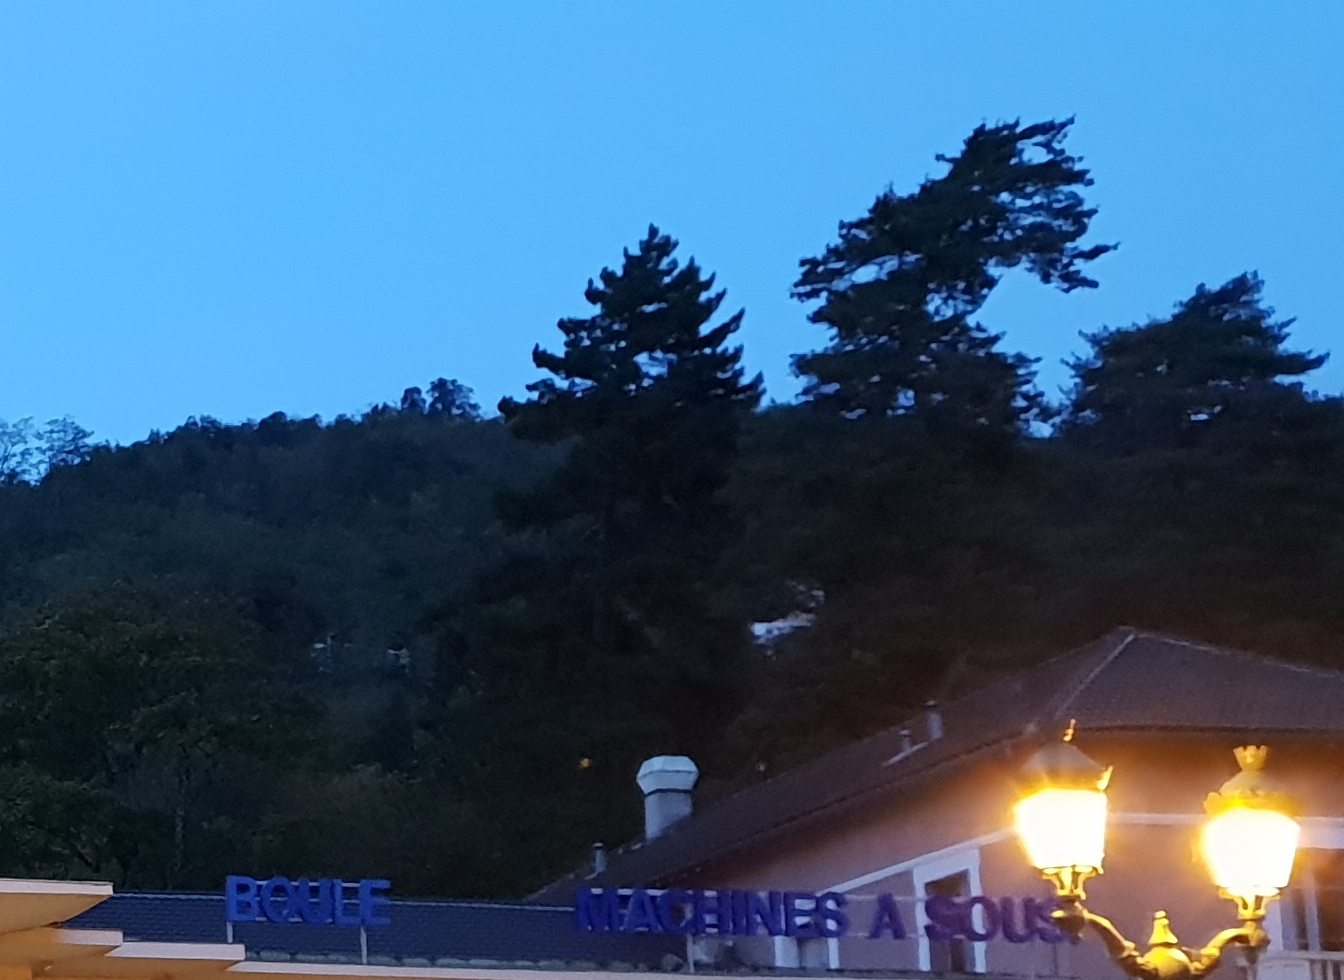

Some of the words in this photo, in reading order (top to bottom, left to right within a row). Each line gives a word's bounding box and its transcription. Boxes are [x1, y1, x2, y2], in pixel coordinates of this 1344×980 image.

[226, 875, 391, 926] BOULE
[575, 887, 850, 938] MACHINES
[868, 893, 907, 940] A
[924, 896, 1069, 943] SOUS
